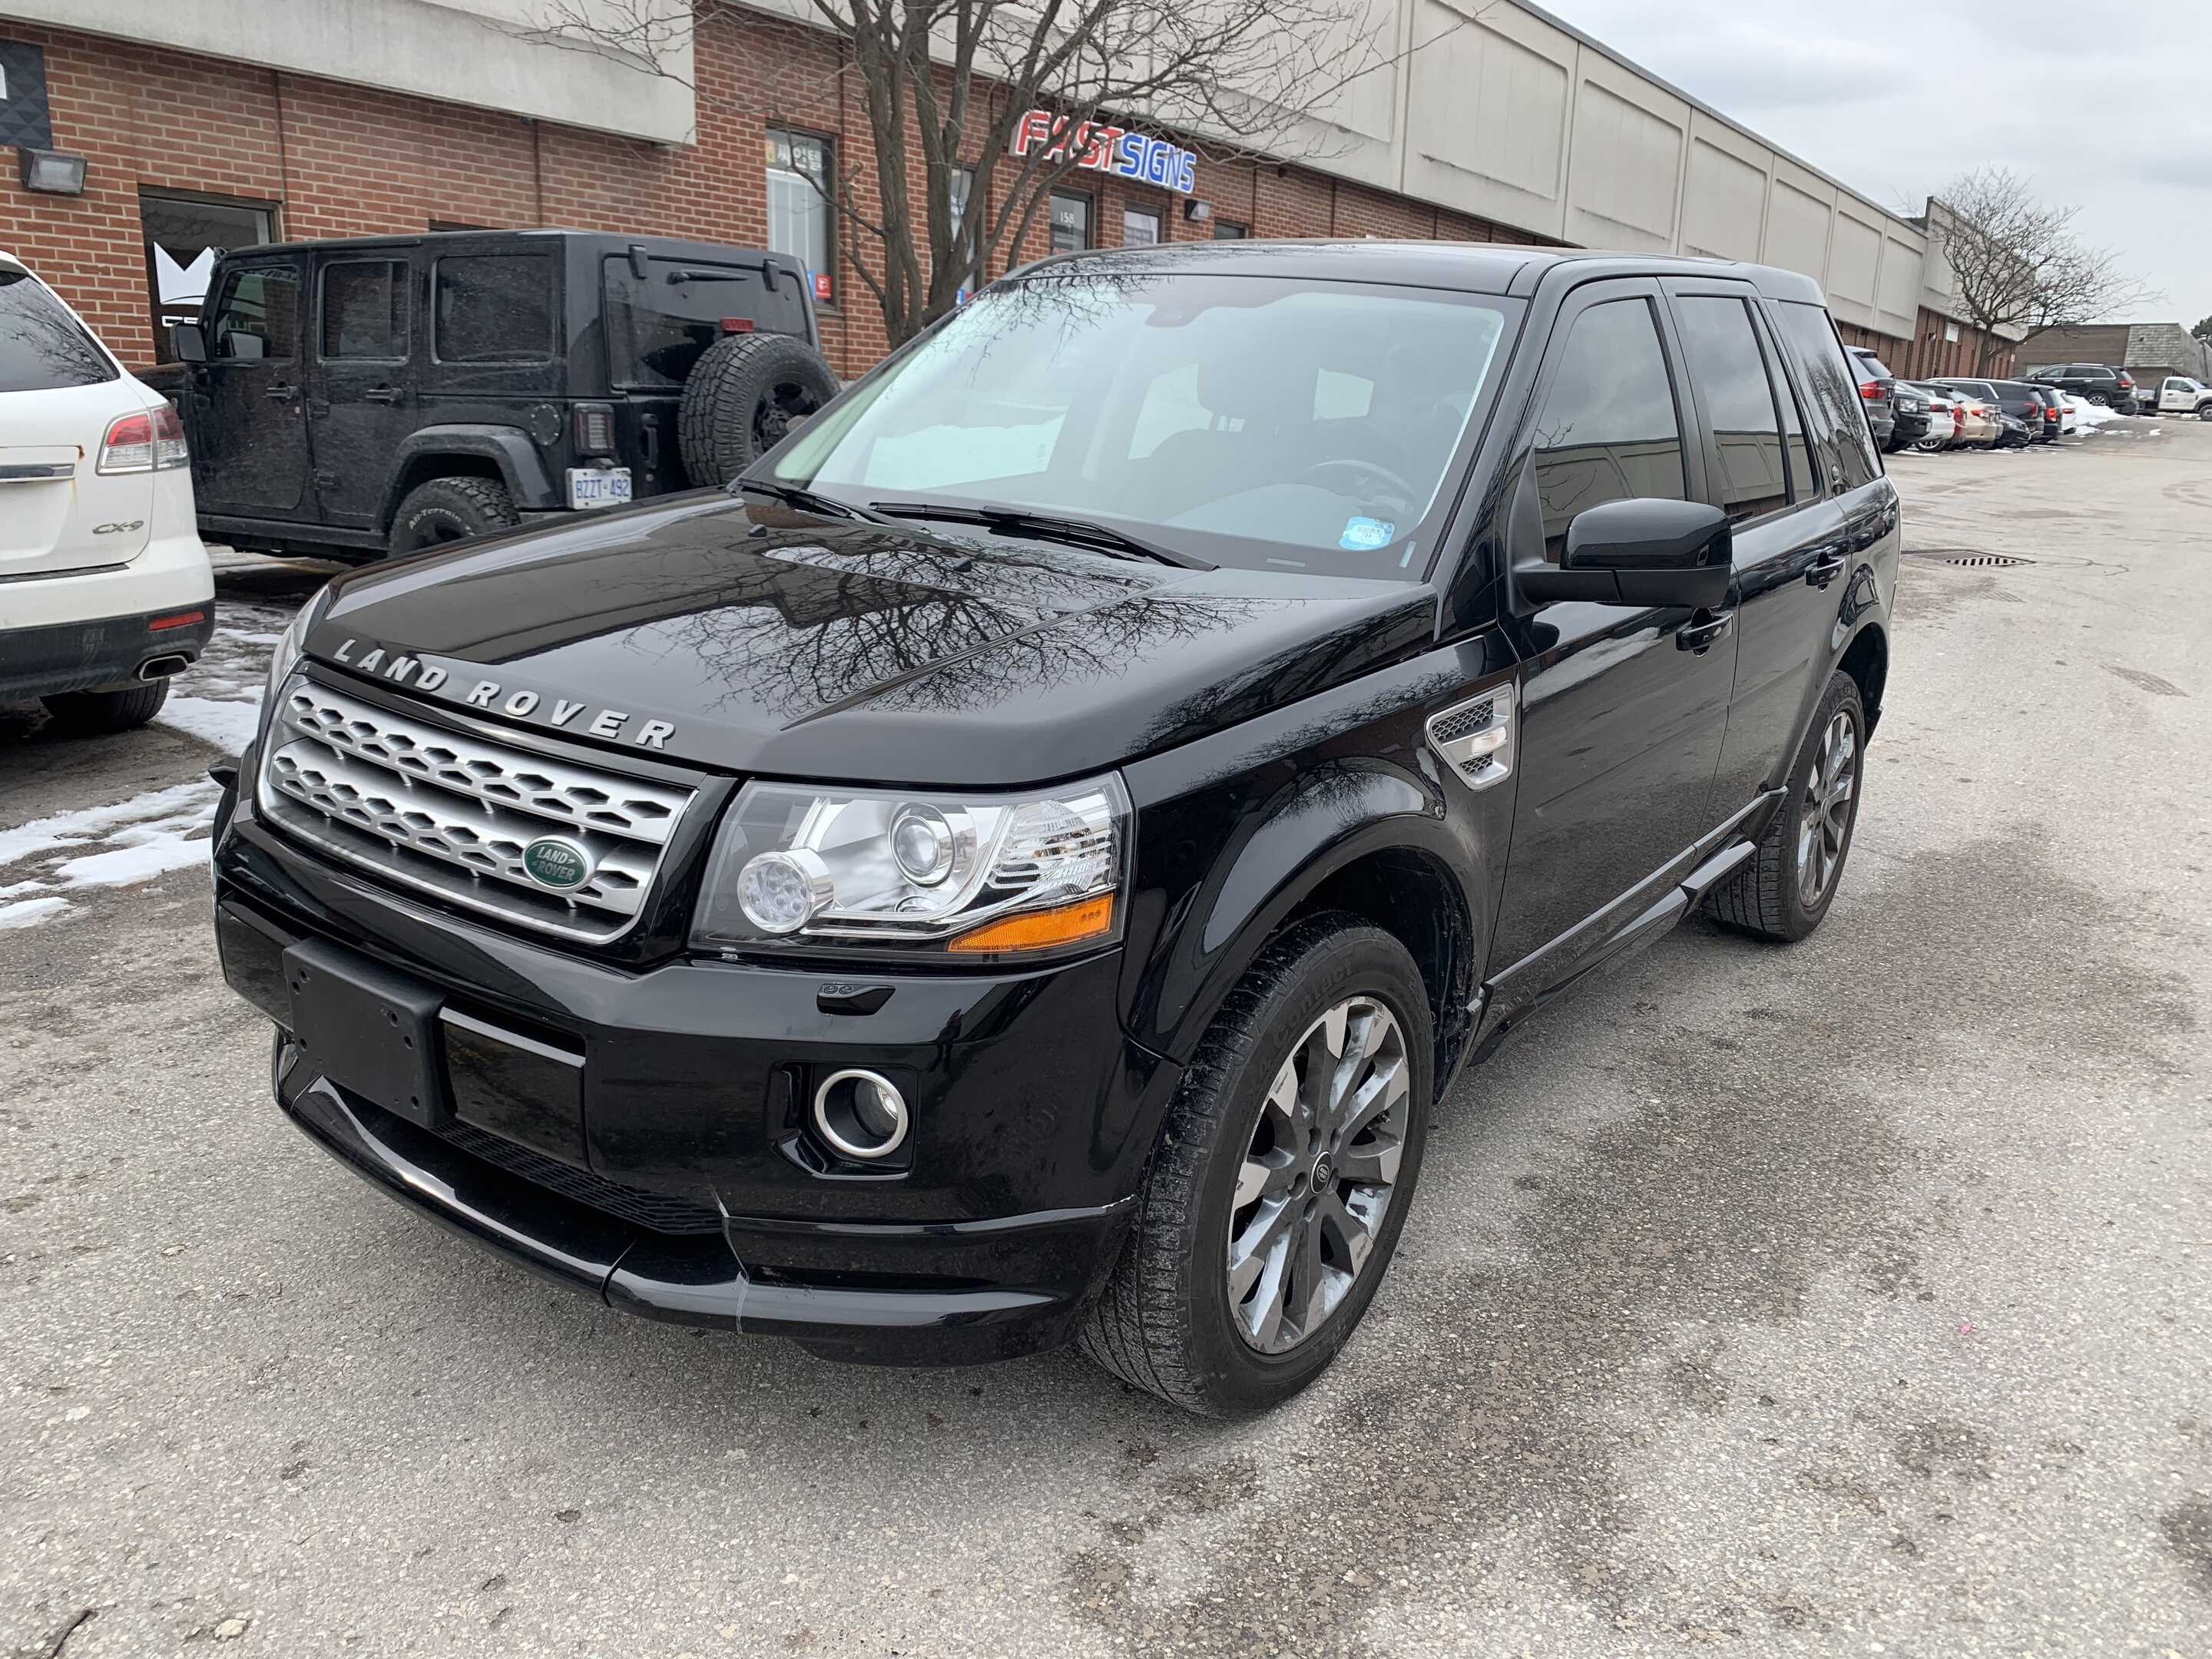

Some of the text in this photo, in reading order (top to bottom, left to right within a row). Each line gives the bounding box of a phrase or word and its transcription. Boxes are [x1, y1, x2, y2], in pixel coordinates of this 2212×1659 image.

[92, 521, 144, 535] CX-9
[333, 639, 676, 749] LAND ROVER
[536, 846, 568, 864] LAND
[538, 861, 575, 881] ROVER
